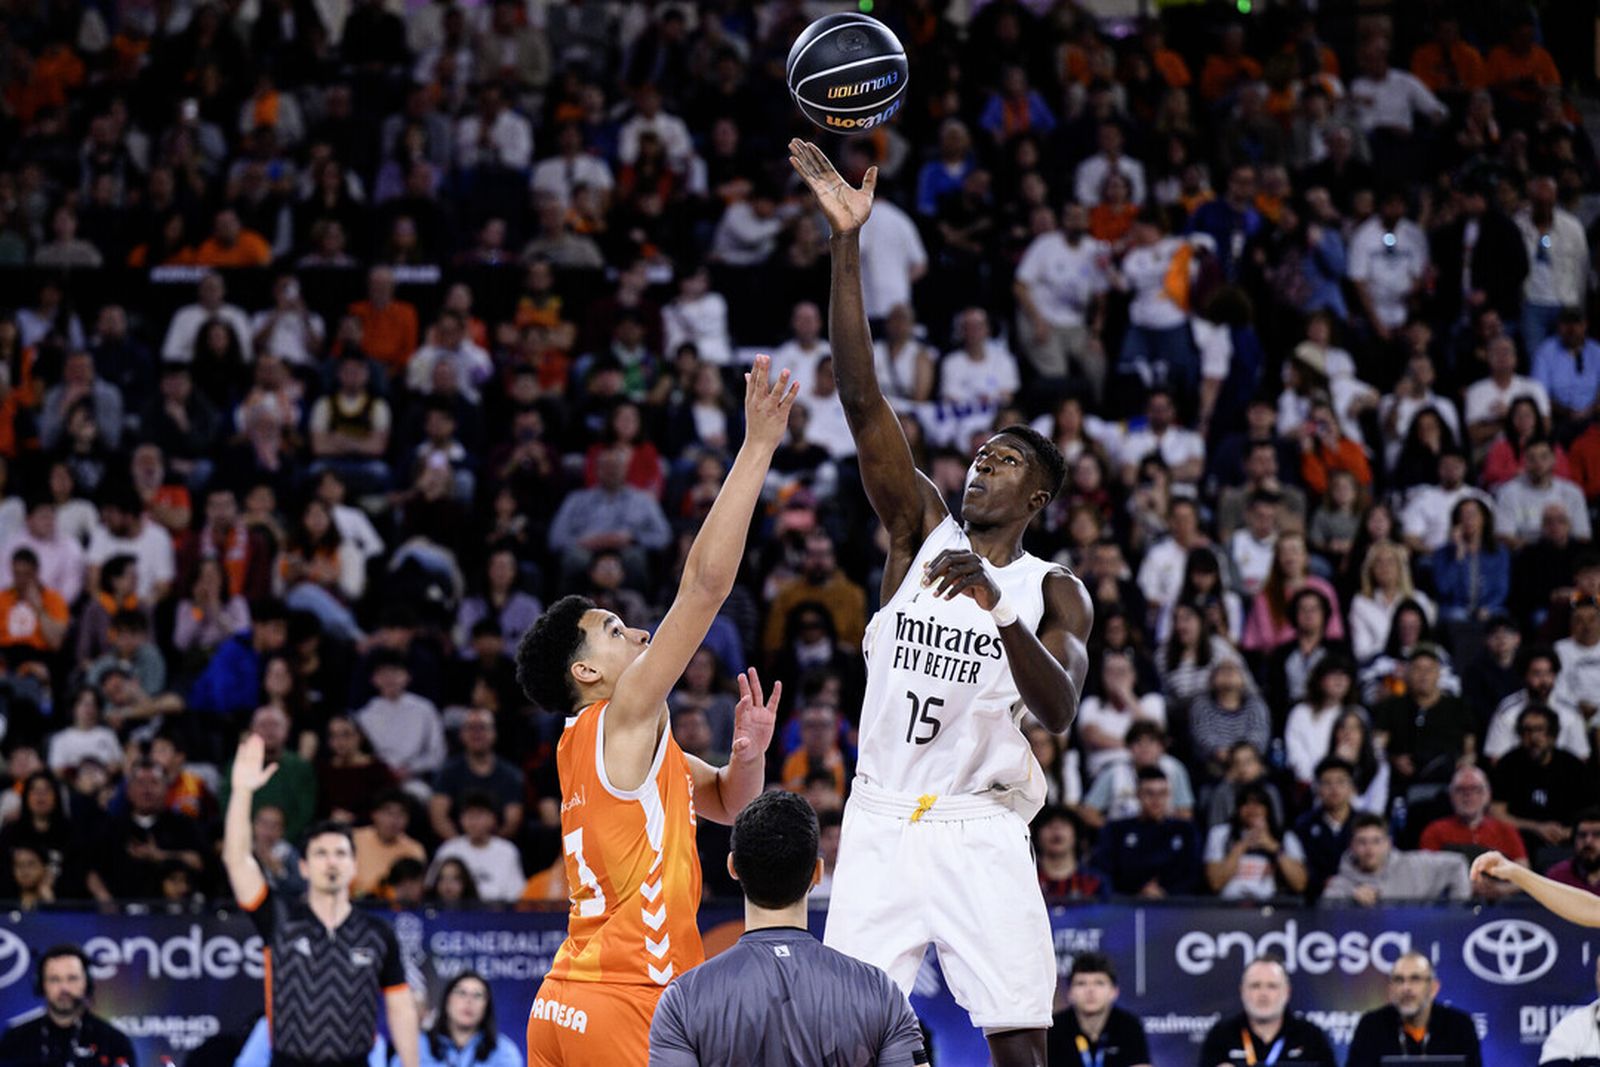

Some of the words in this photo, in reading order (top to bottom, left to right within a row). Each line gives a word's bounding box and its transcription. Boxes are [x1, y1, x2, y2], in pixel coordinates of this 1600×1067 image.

[827, 71, 898, 99] EVOLUTION
[893, 645, 921, 671] FLY
[924, 652, 981, 684] BETTER
[906, 690, 945, 745] 15
[1175, 919, 1413, 975] endesa
